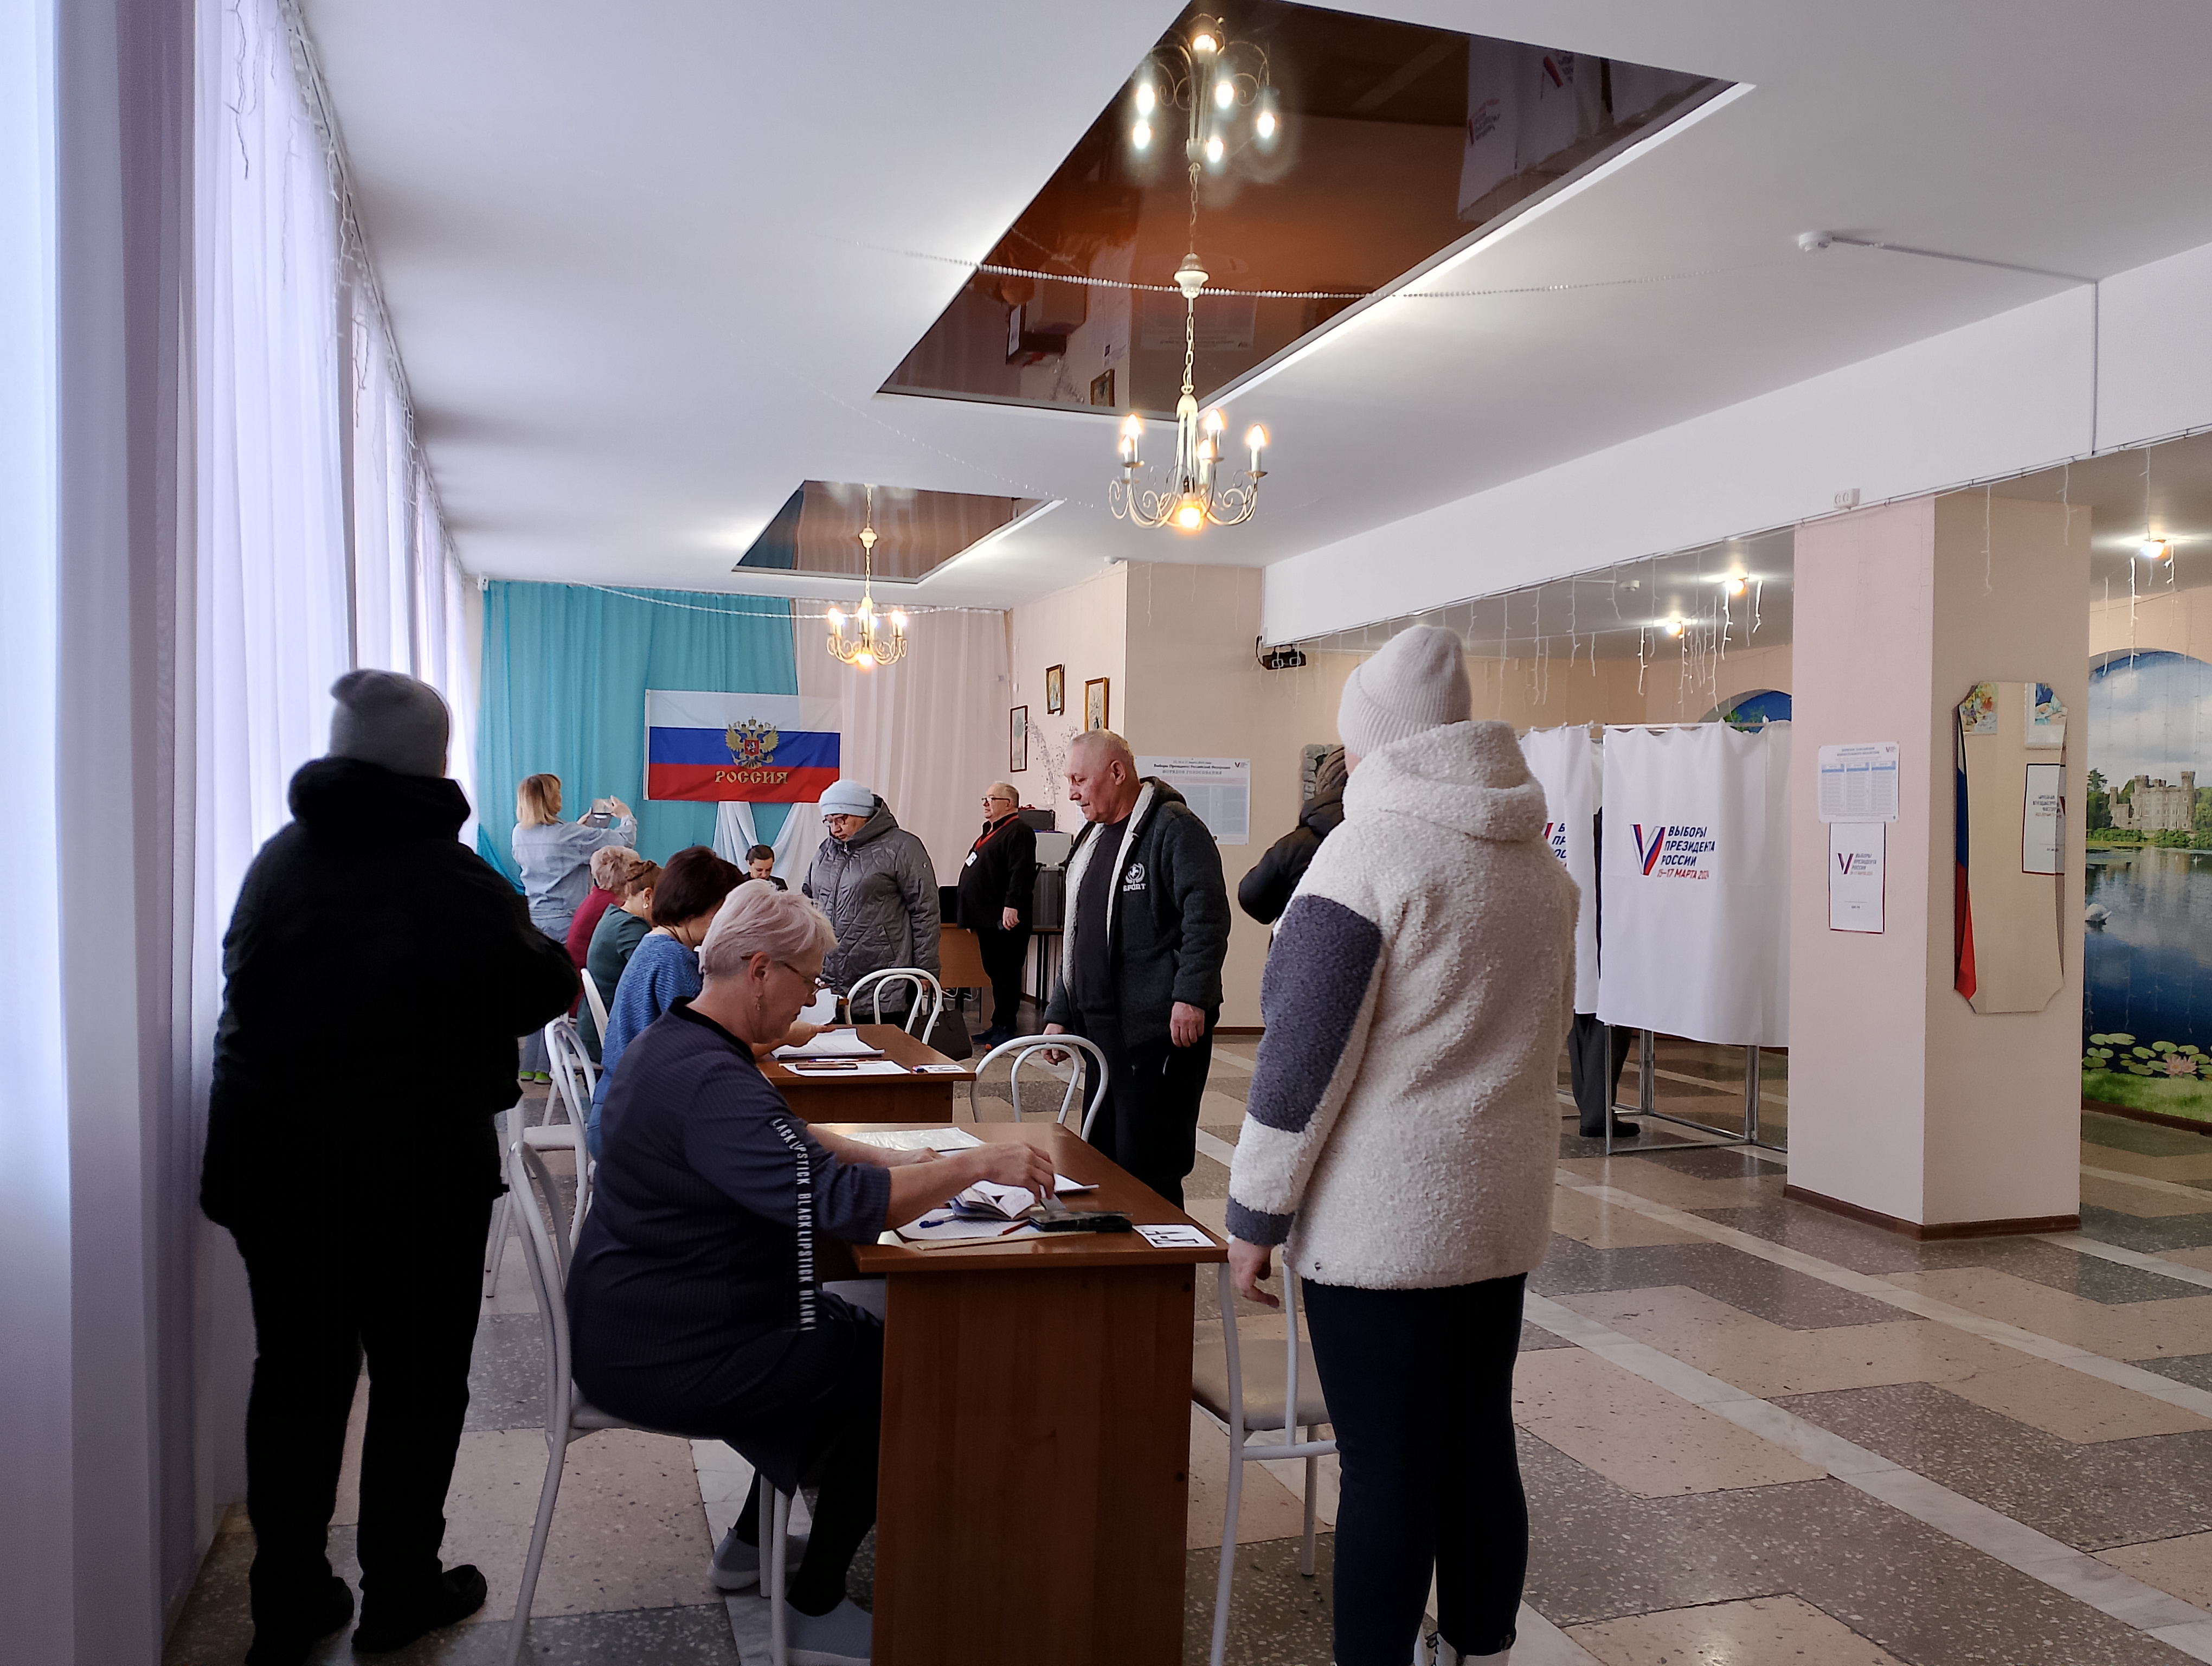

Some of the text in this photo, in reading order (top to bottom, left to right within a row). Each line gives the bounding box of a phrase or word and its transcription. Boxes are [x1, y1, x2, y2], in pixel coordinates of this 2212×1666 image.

[715, 771, 788, 784] РОССИЯ
[1668, 826, 1707, 838] ВЫБОРЫ
[1664, 841, 1715, 854] ПРЕЗИДЕНТА
[1661, 855, 1697, 867] РОССИИ
[1674, 869, 1697, 879] МАРТА
[772, 1118, 797, 1144] LACK
